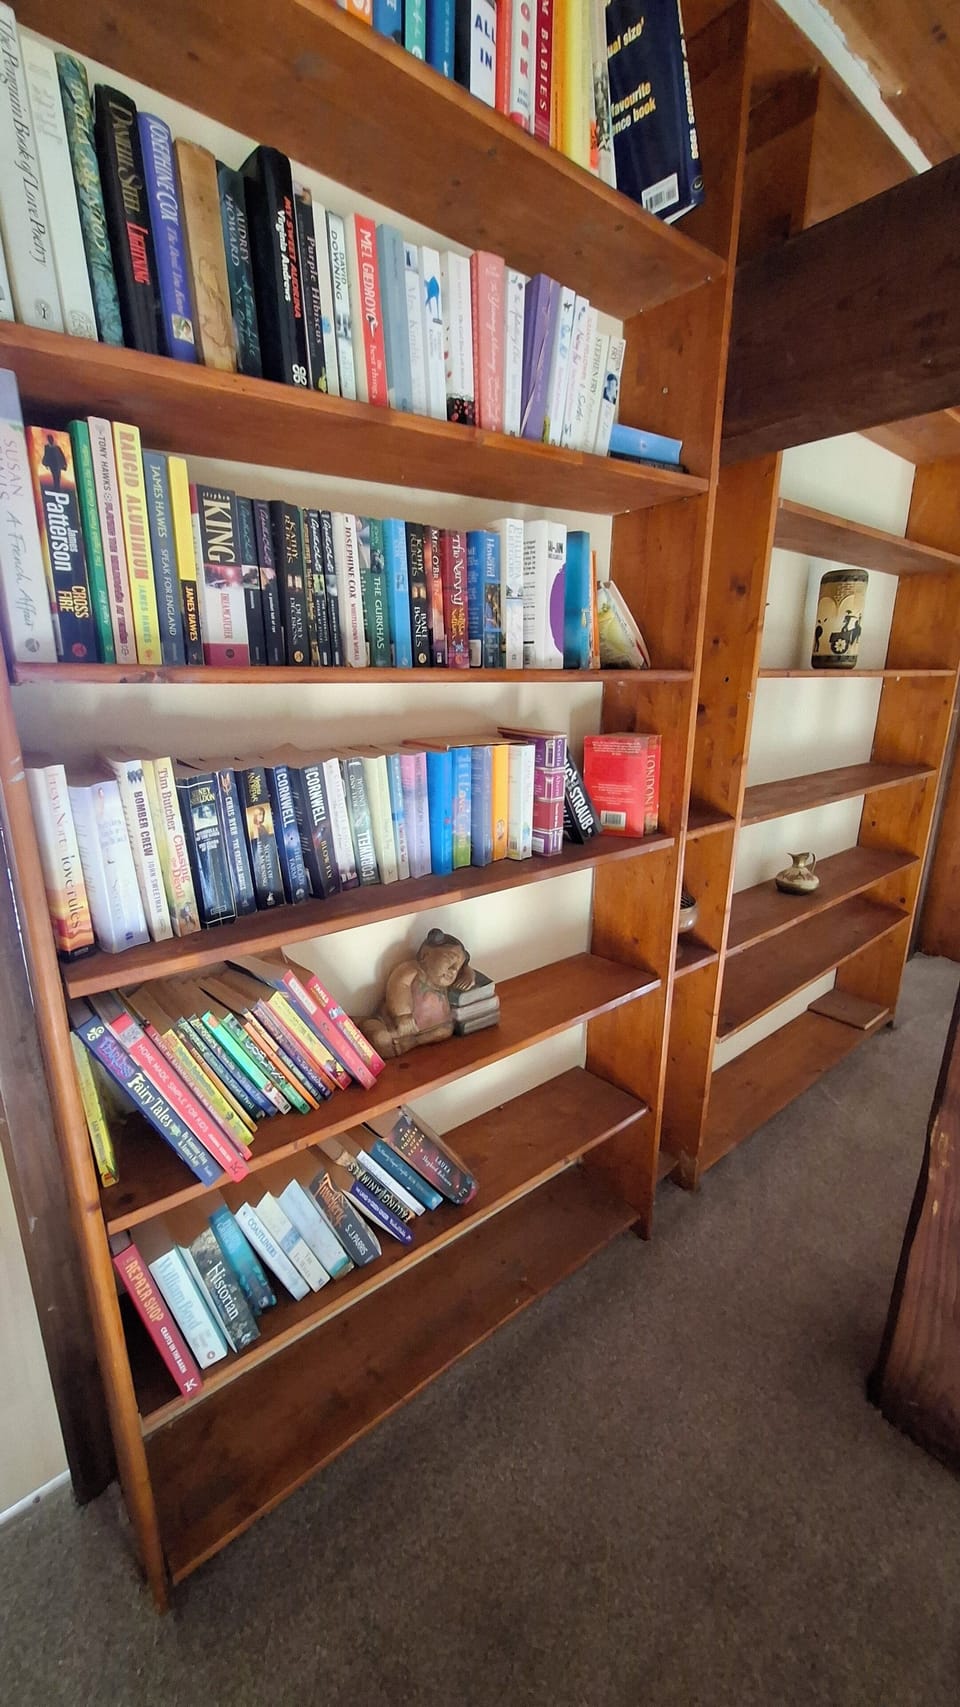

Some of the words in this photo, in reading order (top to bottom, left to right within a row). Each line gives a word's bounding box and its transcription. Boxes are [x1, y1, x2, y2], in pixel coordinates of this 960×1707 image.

[474, 14, 496, 45] ALL
[479, 47, 493, 71] IN
[539, 27, 550, 111] BABIES
[1, 52, 26, 118] Penguin
[610, 80, 651, 117] favourite
[632, 97, 657, 122] book
[13, 118, 31, 160] Book
[146, 118, 175, 192] JOSEPHINE
[16, 158, 38, 182] of
[23, 176, 41, 222] Love
[157, 189, 180, 222] COX
[28, 216, 47, 266] Poetry
[224, 193, 240, 266] HOWARD
[234, 206, 249, 264] AUDREY
[273, 209, 288, 252] Virginia
[285, 219, 297, 262] SWEET
[359, 228, 372, 262] MEL
[280, 253, 293, 301] Andrews
[305, 235, 317, 282] Purple
[330, 230, 342, 300] DOWNING
[289, 263, 302, 318] AUDRINA
[310, 287, 323, 344] Hibiscus
[590, 337, 604, 377] STEPHEN
[589, 377, 598, 394] FRY
[3, 438, 23, 497] SUSAN
[97, 436, 107, 459] TONY
[116, 428, 140, 488] RANCID
[99, 460, 111, 491] HAWKS
[149, 463, 164, 498] JAMES
[44, 490, 72, 571] Patterson
[123, 492, 151, 581] ALUMINIUM
[153, 500, 169, 538] HAWES
[203, 499, 236, 562] KING
[9, 532, 29, 584] French
[68, 528, 79, 553] James
[288, 521, 298, 559] KATHY
[345, 526, 354, 577] JOSEPHINE
[409, 533, 419, 576] REICHS
[415, 538, 423, 572] KATHY
[452, 534, 464, 557] The
[485, 537, 495, 576] Howard
[159, 547, 171, 575] SPEAK
[58, 591, 74, 613] FIRE
[163, 575, 173, 594] FOR
[182, 585, 195, 612] JAMES
[348, 579, 356, 599] COX
[373, 576, 381, 596] THE
[448, 559, 465, 605] Nanny
[71, 586, 89, 619] CROSS
[163, 593, 178, 636] ENGLAND
[220, 593, 233, 640] DREAMCATCHER
[294, 603, 303, 639] DEADLY
[186, 612, 199, 641] HAWES
[373, 599, 385, 649] GURKHAS
[413, 606, 423, 647] BONES
[419, 612, 428, 638] BARE
[157, 767, 171, 789] Tim
[645, 753, 655, 806] LONDON
[133, 790, 148, 829] BOMBER
[160, 790, 178, 831] Butcher
[276, 772, 295, 828] CORNWELL
[305, 770, 327, 826] CORNWELL
[319, 839, 331, 863] BLOW
[567, 785, 595, 830] STRAUB
[139, 830, 153, 857] CREW
[172, 834, 191, 883] Chasing
[356, 828, 375, 877] CORNWELL
[147, 860, 156, 878] JOHN
[171, 868, 185, 899] Devil
[266, 870, 274, 879] OF
[288, 857, 297, 878] FARM
[295, 863, 304, 884] BODY
[65, 887, 86, 928] rules
[150, 878, 162, 913] SWEETMAN
[153, 1036, 167, 1051] WANT
[127, 1073, 152, 1105] Fairy
[150, 1099, 173, 1128] Tales
[136, 1044, 154, 1063] HOME
[152, 1063, 169, 1081] MADE
[166, 1082, 187, 1104] SIMPLE
[184, 1104, 197, 1118] FOR
[195, 1117, 209, 1132] KIDS
[346, 1162, 384, 1196] ANIMALS
[434, 1156, 451, 1174] LAURA
[381, 1192, 412, 1222] FALLING
[352, 1232, 369, 1256] PARRIS
[125, 1260, 152, 1299] REPAIR
[142, 1293, 164, 1322] SHOP
[157, 1257, 189, 1310] William
[206, 1260, 239, 1320] Historian
[159, 1327, 173, 1344] CRAFTS
[171, 1349, 180, 1359] THE
[176, 1359, 187, 1373] BARN
